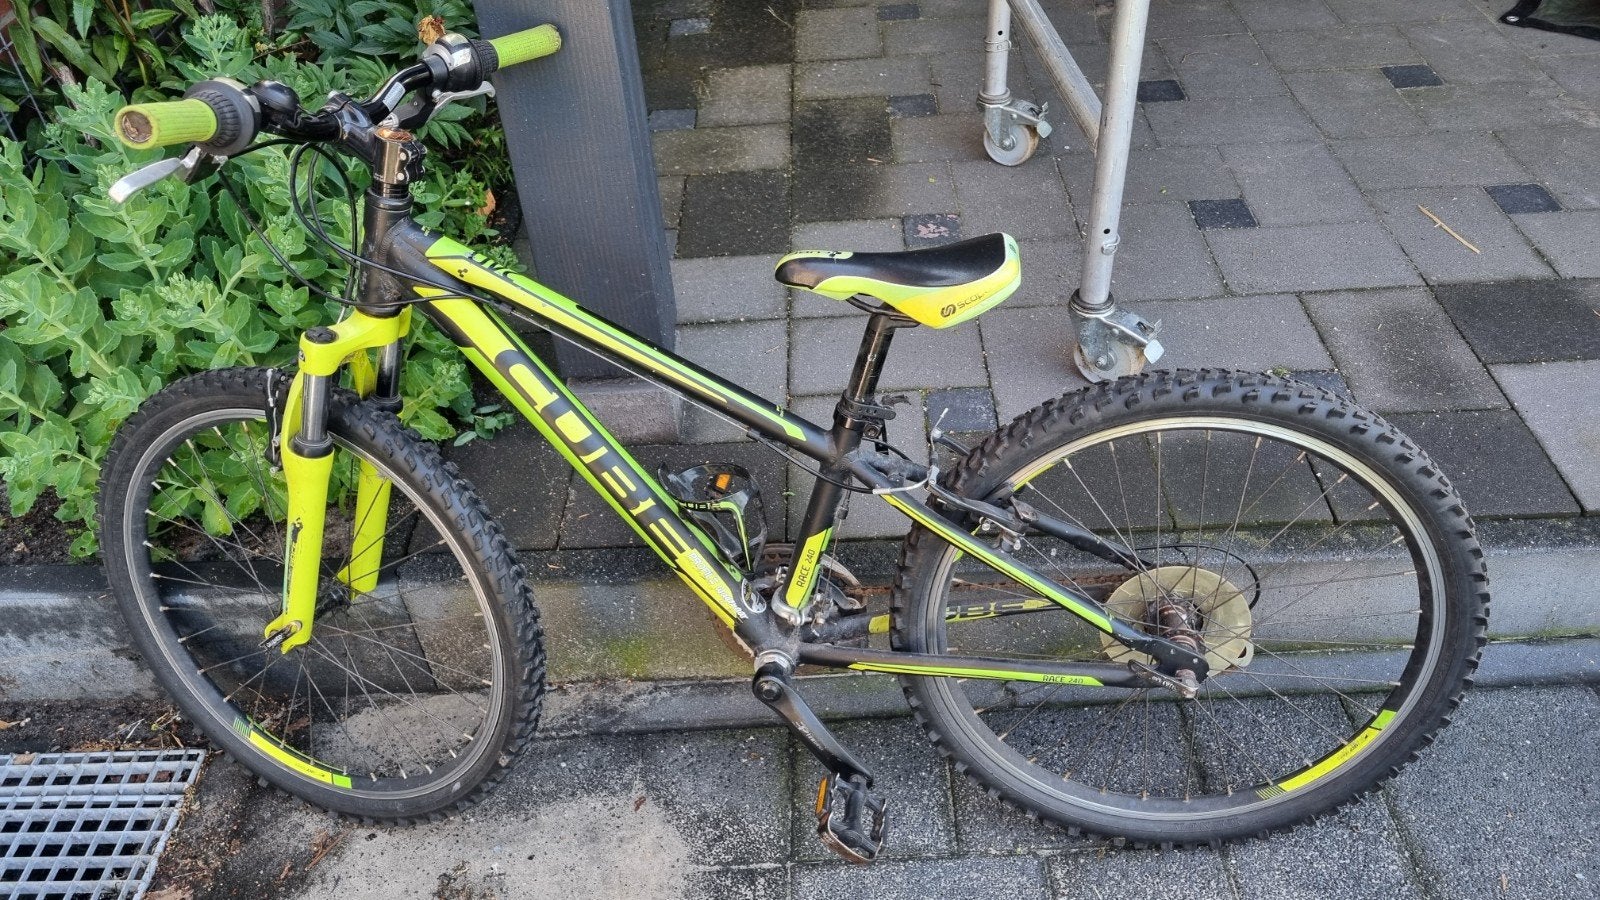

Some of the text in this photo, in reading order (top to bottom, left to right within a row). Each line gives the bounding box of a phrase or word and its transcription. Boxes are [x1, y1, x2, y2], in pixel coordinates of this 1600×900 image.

[494, 348, 693, 562] CUBE
[796, 549, 816, 588] RACE 240
[1042, 674, 1065, 683] RACE
